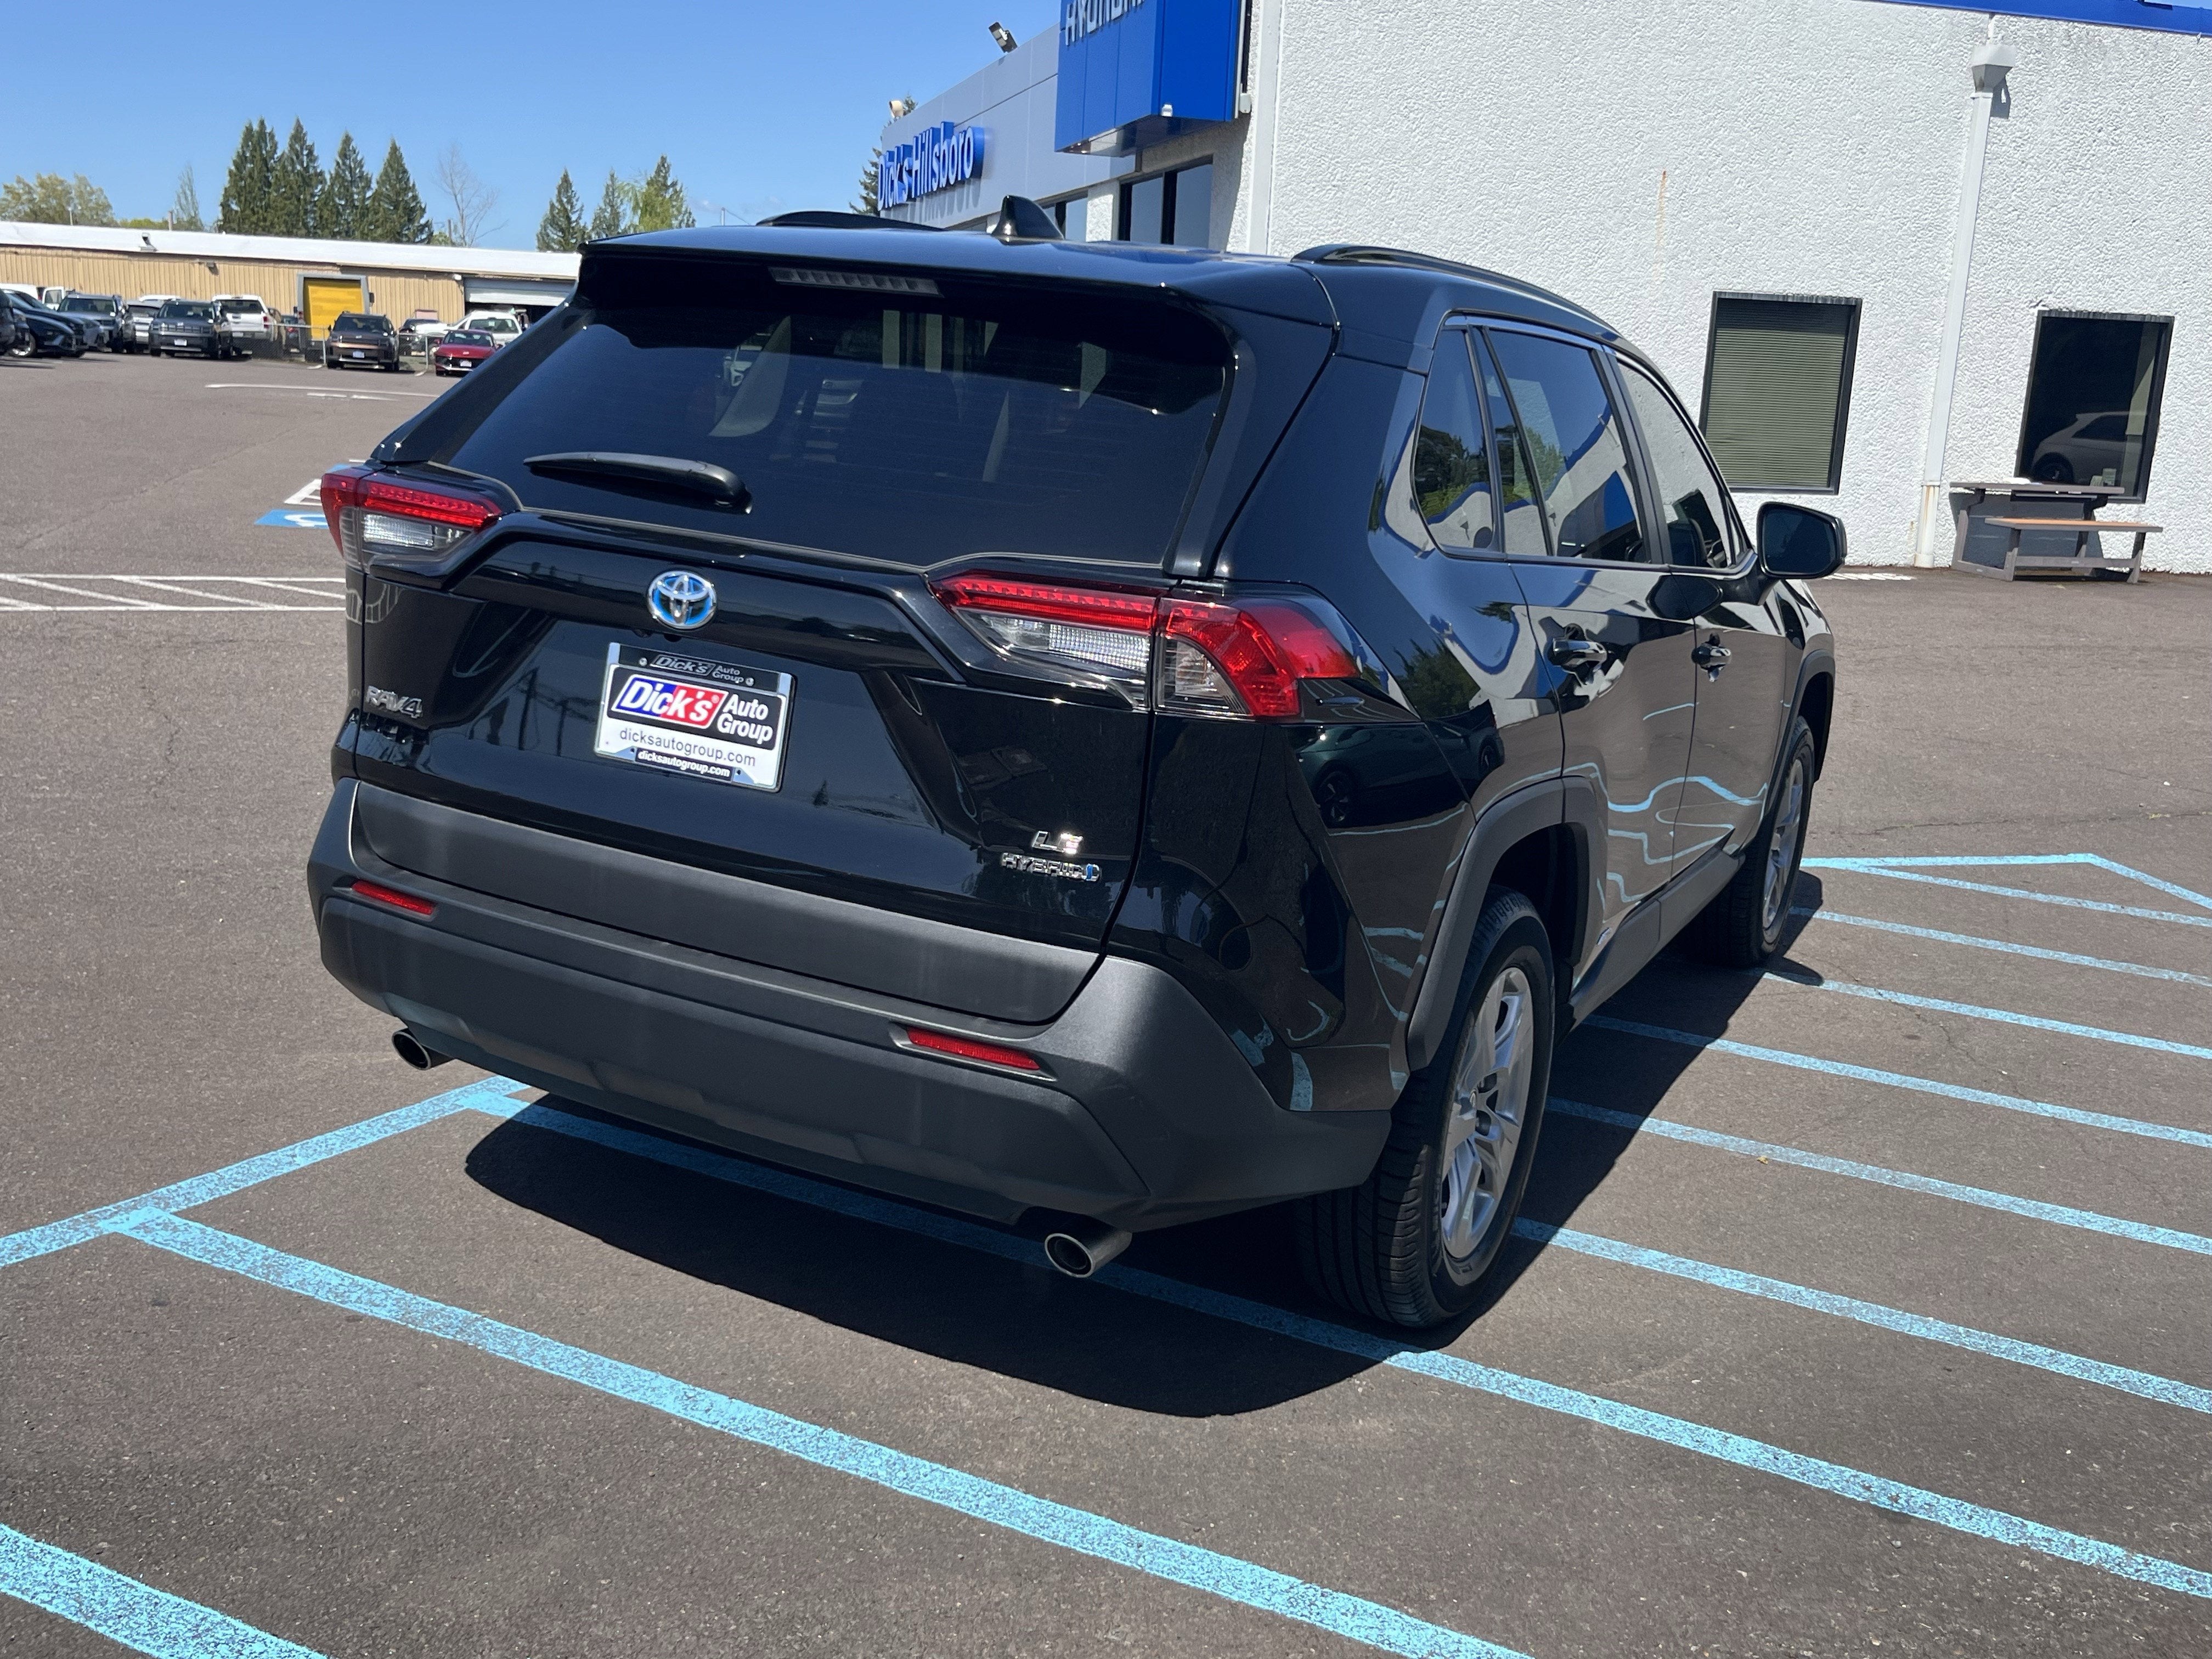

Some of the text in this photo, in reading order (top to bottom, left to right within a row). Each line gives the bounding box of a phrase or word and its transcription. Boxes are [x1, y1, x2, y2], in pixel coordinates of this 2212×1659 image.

[877, 121, 975, 212] Dick's Hillsboro
[656, 657, 741, 676] Dick's Auto
[712, 672, 744, 684] Group
[366, 685, 423, 718] RAV4
[620, 680, 769, 722] Dick's Auto
[717, 713, 773, 744] Group
[620, 728, 756, 767] dicksautogroup.com
[637, 750, 730, 777] dicksautogroup.com
[1031, 831, 1084, 855] LE
[1001, 853, 1085, 879] HYBRID
